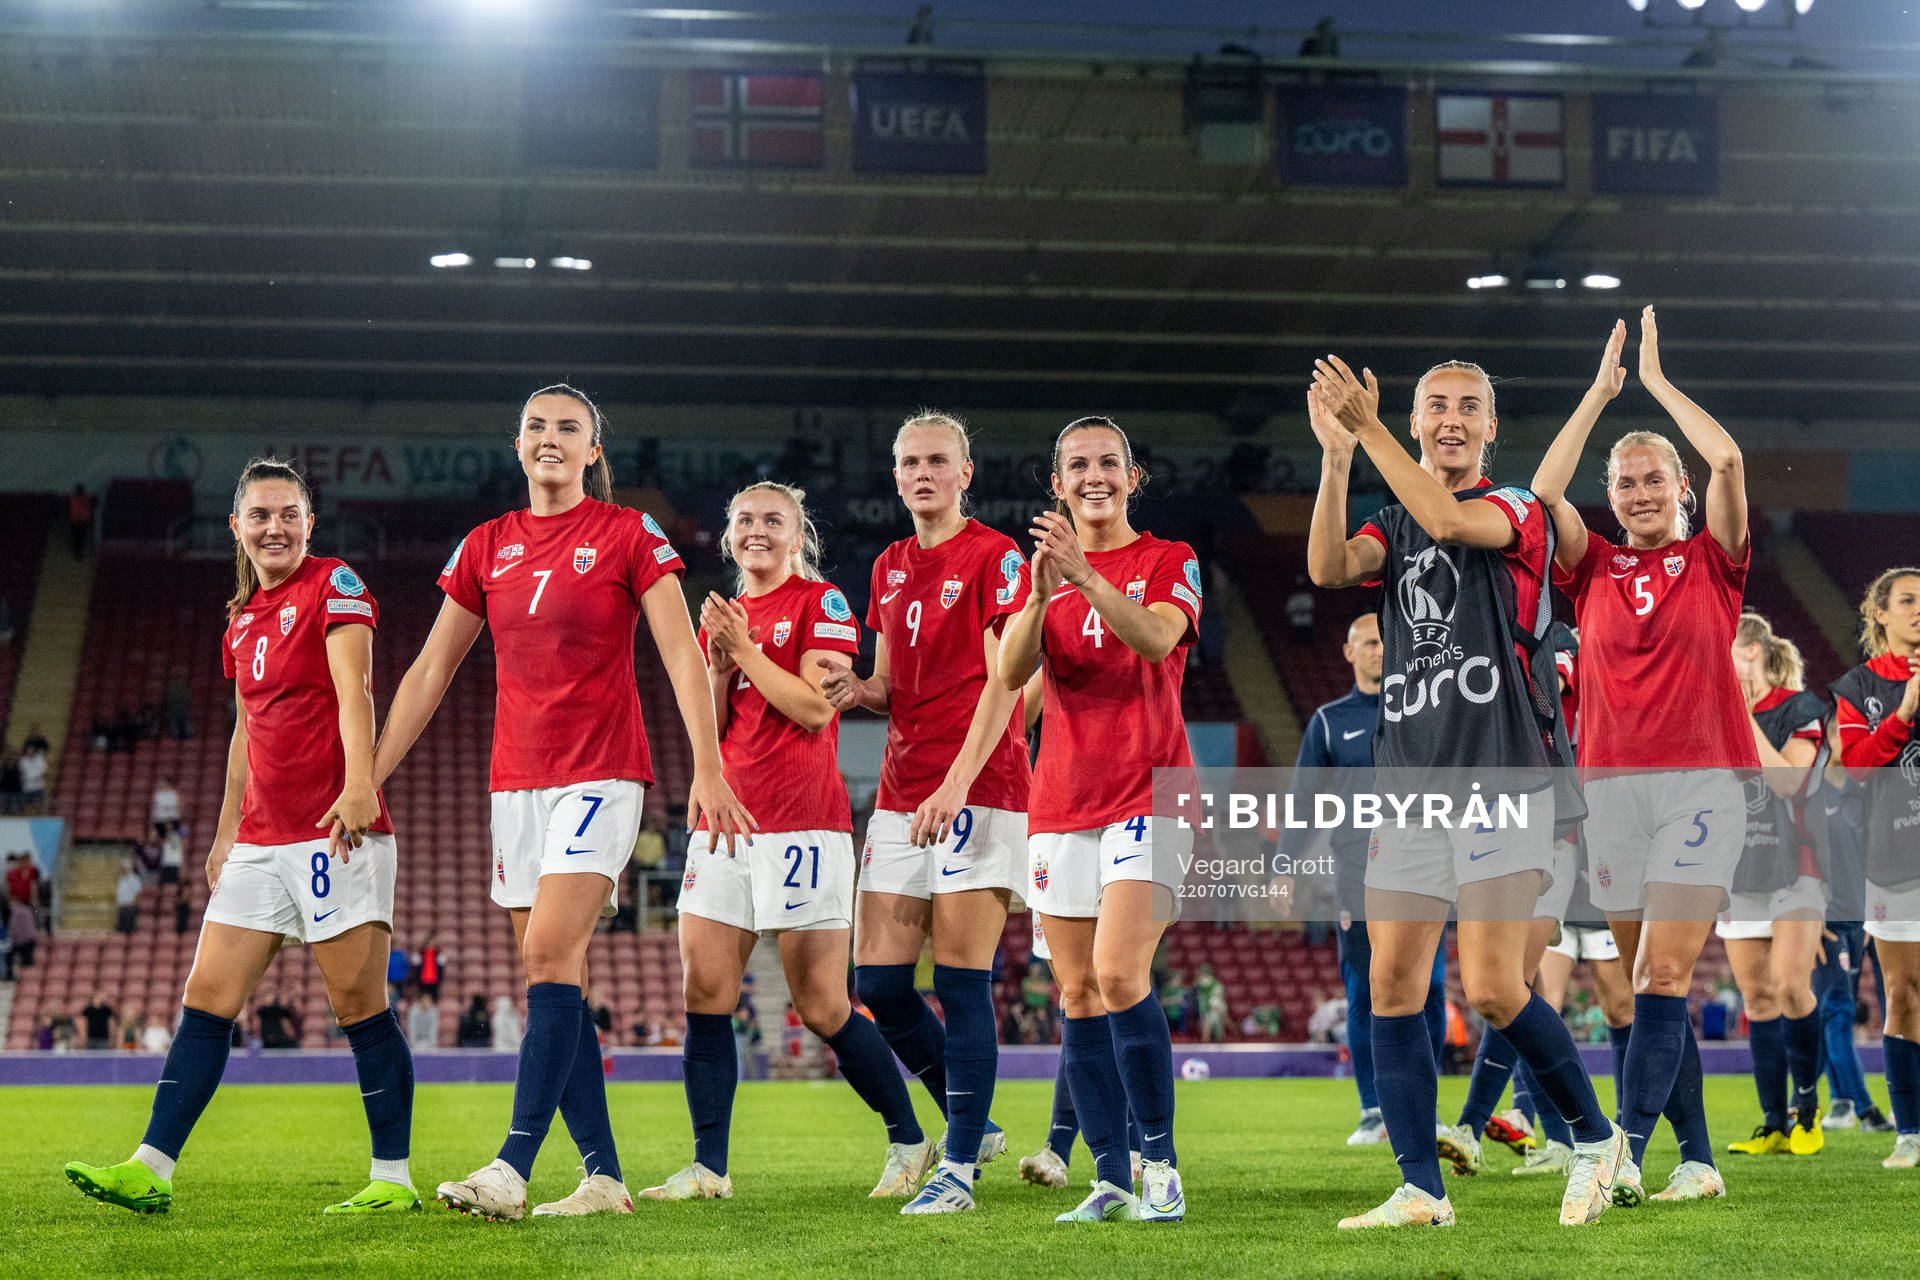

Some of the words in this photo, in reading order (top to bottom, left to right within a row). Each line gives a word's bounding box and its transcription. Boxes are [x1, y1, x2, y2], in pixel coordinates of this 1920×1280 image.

[869, 104, 969, 142] UEFA
[1607, 128, 1697, 162] FIFA
[528, 570, 553, 615] 7
[1634, 575, 1655, 616] 5
[906, 600, 922, 647] 9
[1082, 606, 1104, 648] 4
[1413, 627, 1447, 644] EFA
[252, 636, 268, 681] 8
[574, 795, 604, 837] 7
[952, 808, 973, 854] 9
[1124, 816, 1147, 842] 4
[1684, 808, 1713, 848] 5
[311, 851, 330, 898] 8
[783, 845, 819, 889] 21
